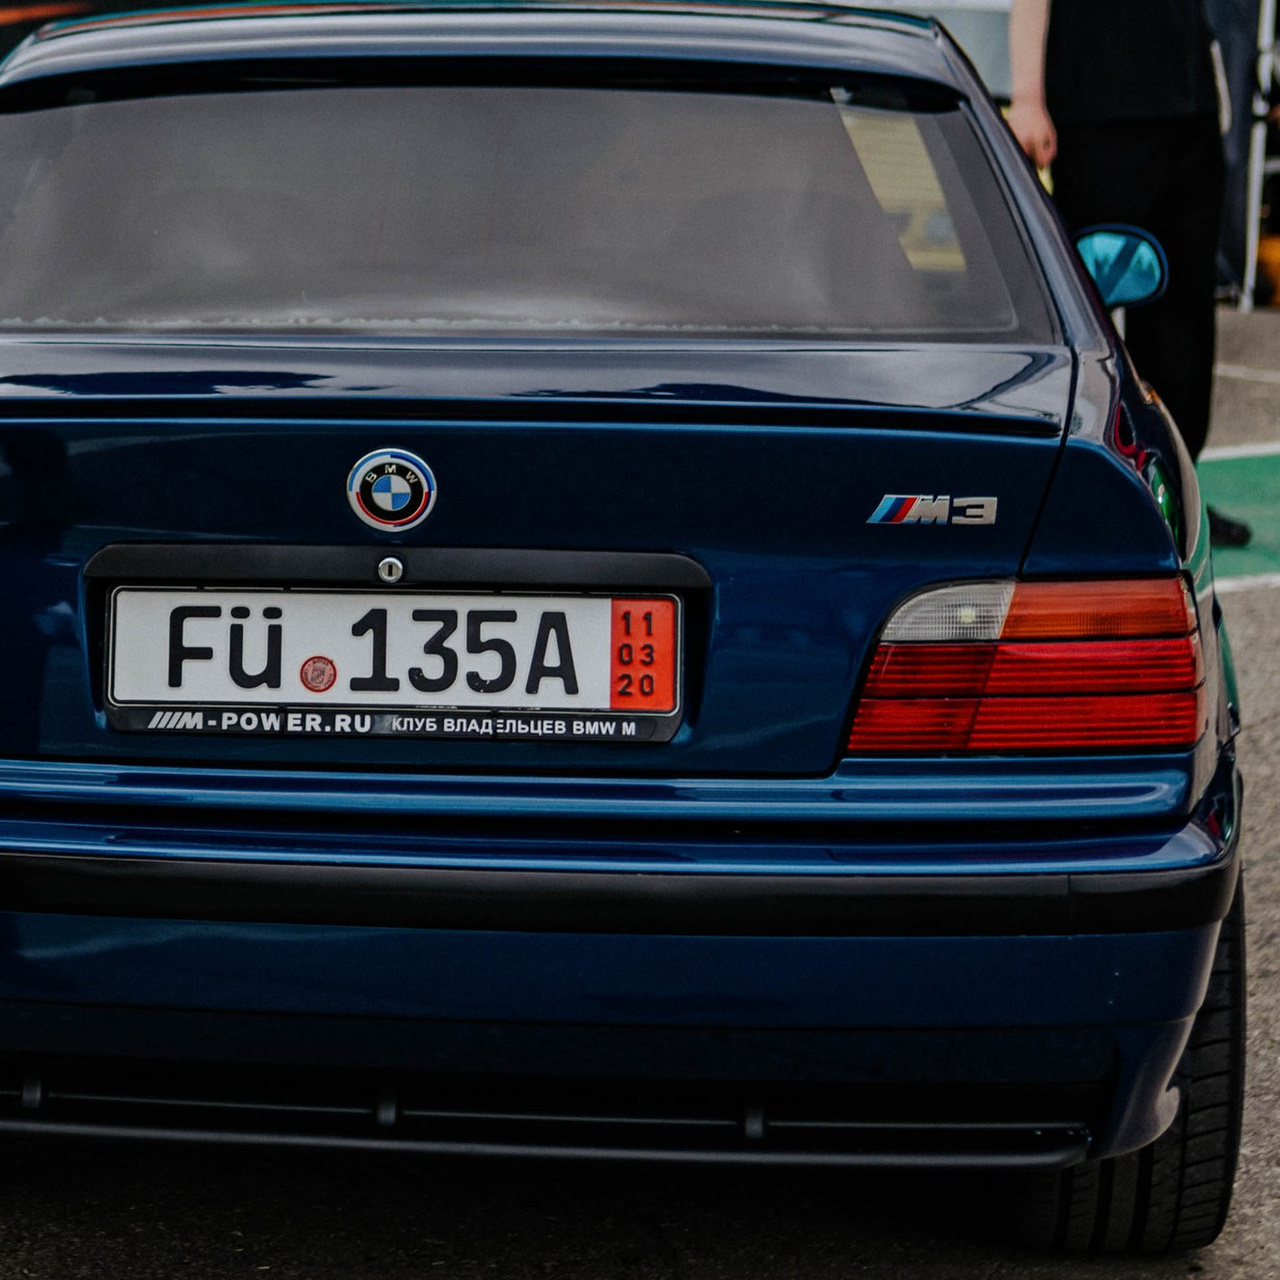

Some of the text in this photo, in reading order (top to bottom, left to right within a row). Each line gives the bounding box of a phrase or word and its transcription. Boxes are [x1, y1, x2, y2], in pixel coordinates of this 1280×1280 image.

[365, 464, 419, 484] BMW
[898, 494, 998, 525] M3
[622, 610, 653, 636] 11
[168, 605, 580, 696] FÜ 135A
[618, 642, 655, 666] 03
[618, 673, 655, 696] 20
[391, 716, 636, 736] КЛУБ ВЛАДЕЛЬЦЕВ BMW M
